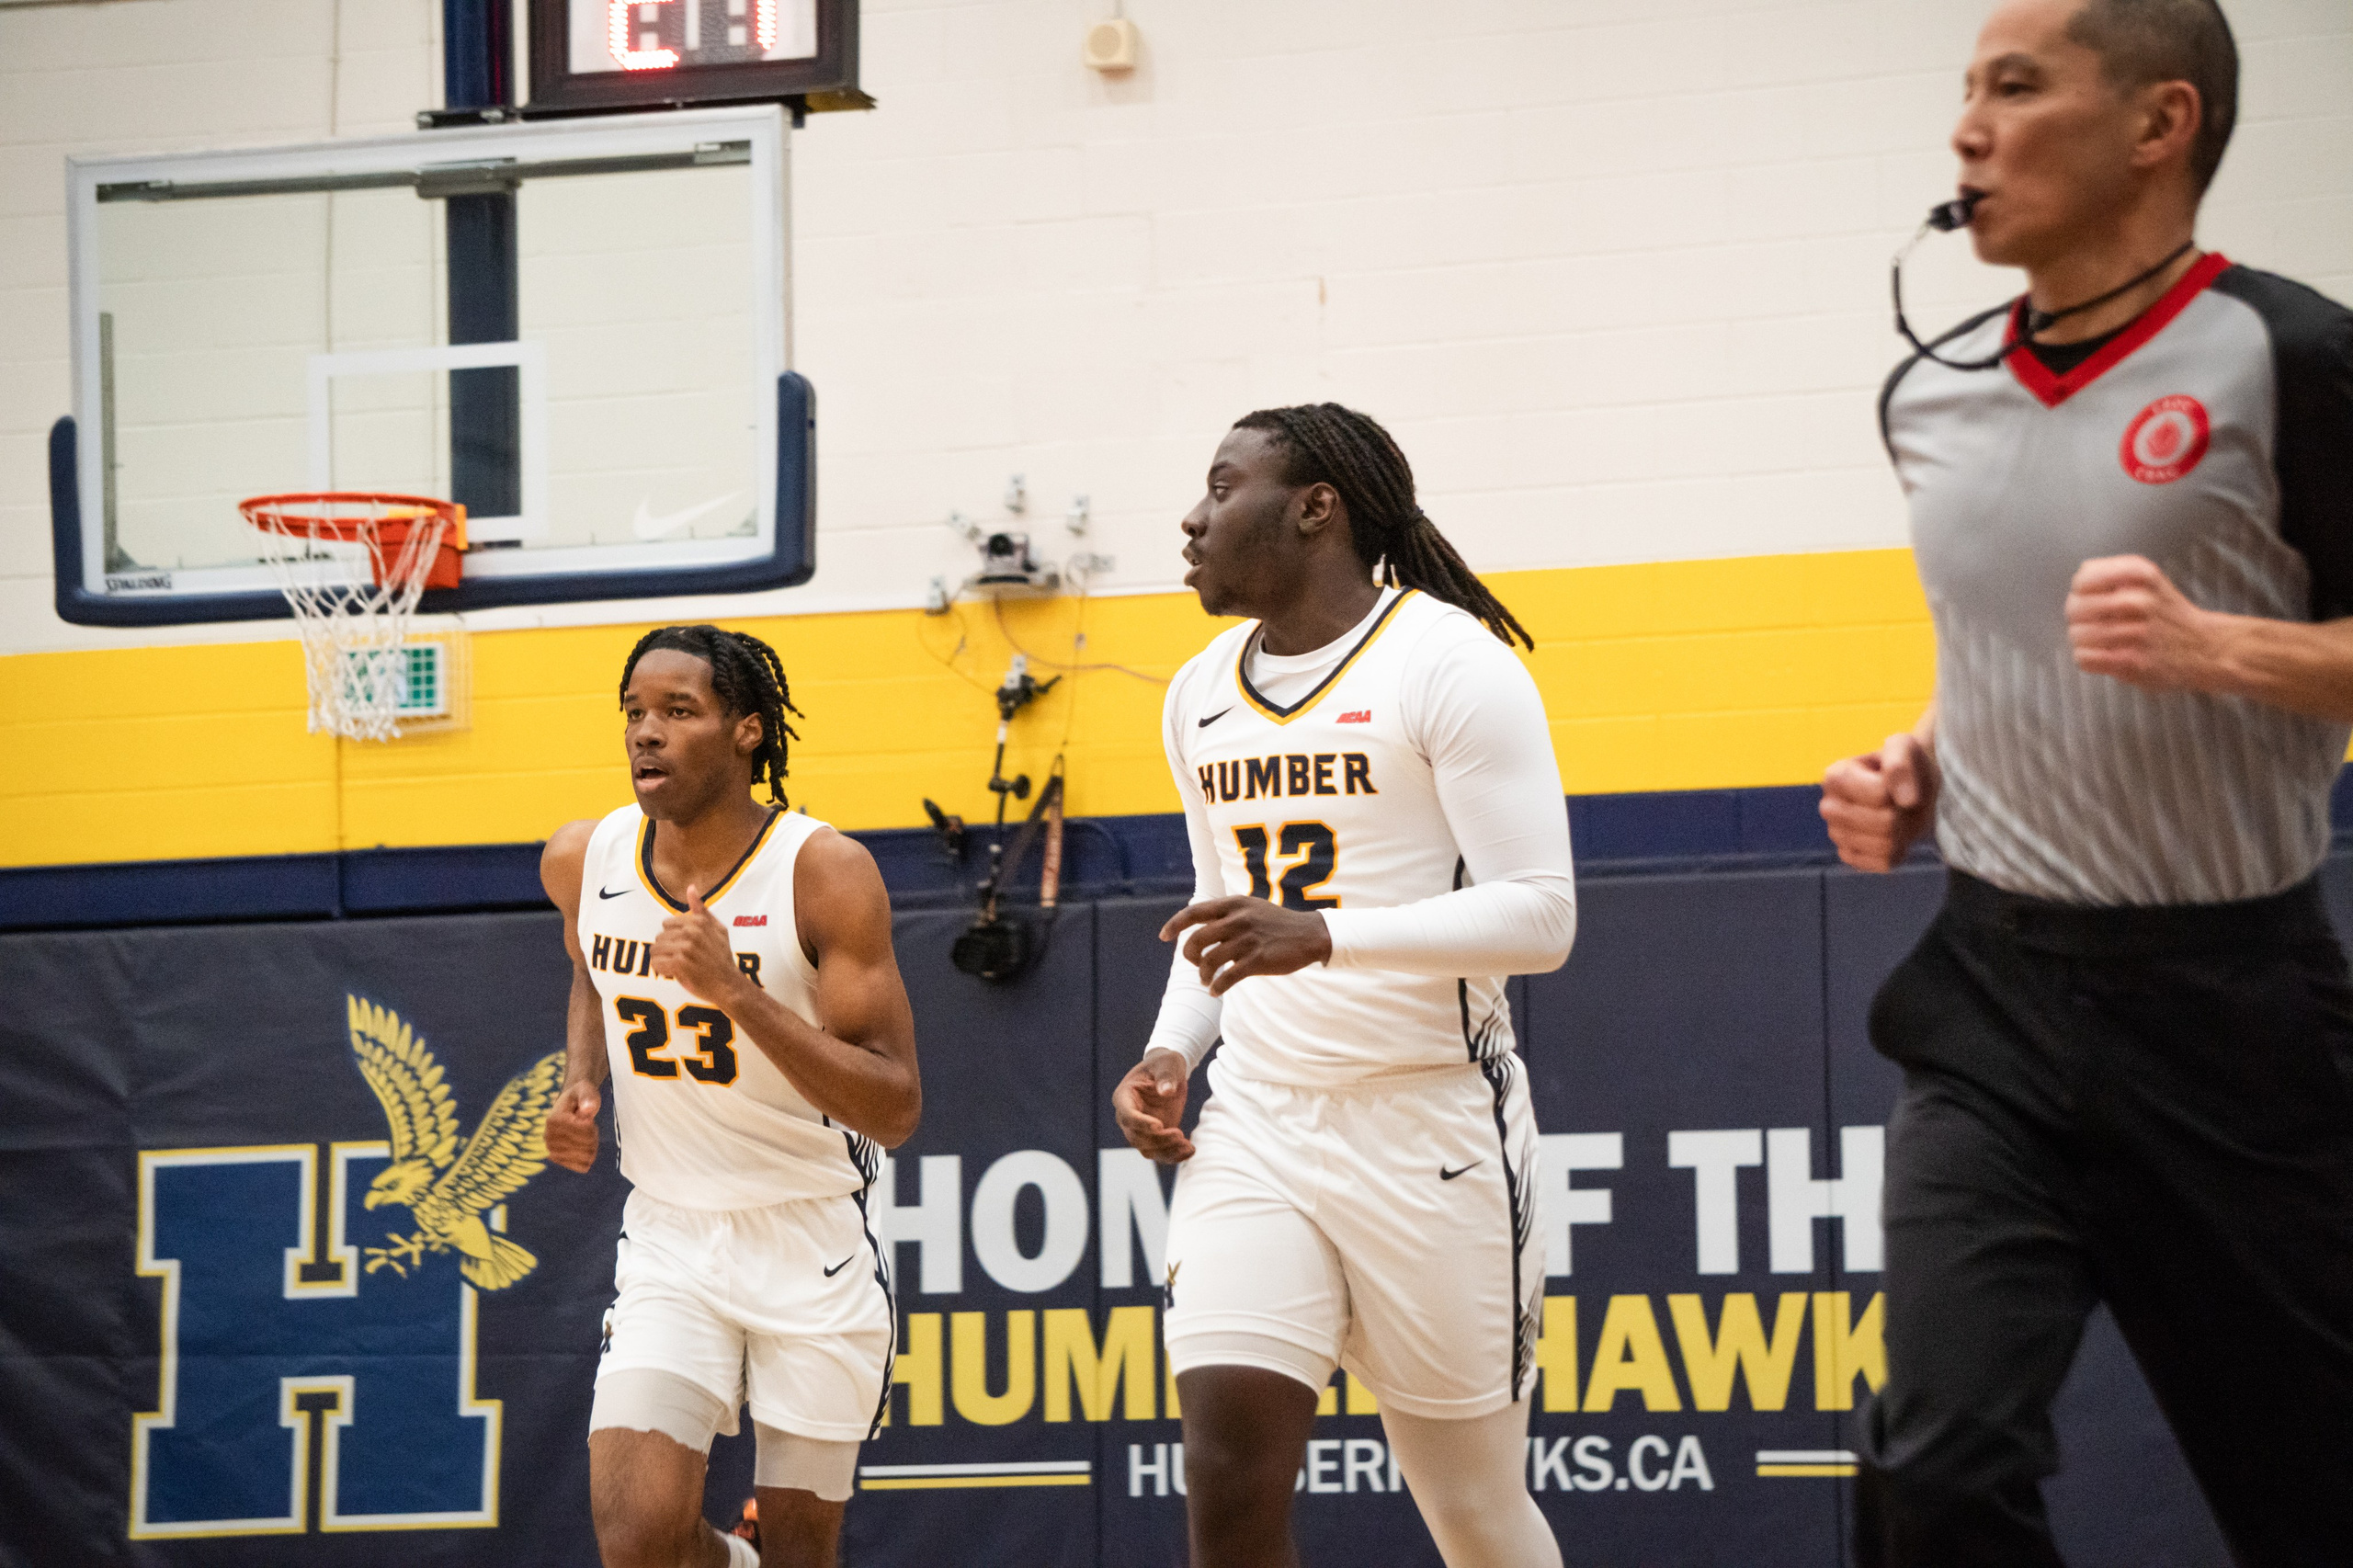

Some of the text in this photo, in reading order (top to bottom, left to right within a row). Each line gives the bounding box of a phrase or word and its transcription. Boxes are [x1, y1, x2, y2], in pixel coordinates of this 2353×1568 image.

[1198, 752, 1379, 804] HUMBER
[1231, 820, 1342, 911] 12
[592, 933, 765, 989] HUR
[614, 994, 740, 1087] 23
[880, 1147, 1180, 1295] HOM
[1667, 1124, 1885, 1276] TH
[1535, 1290, 1889, 1413] HAWK
